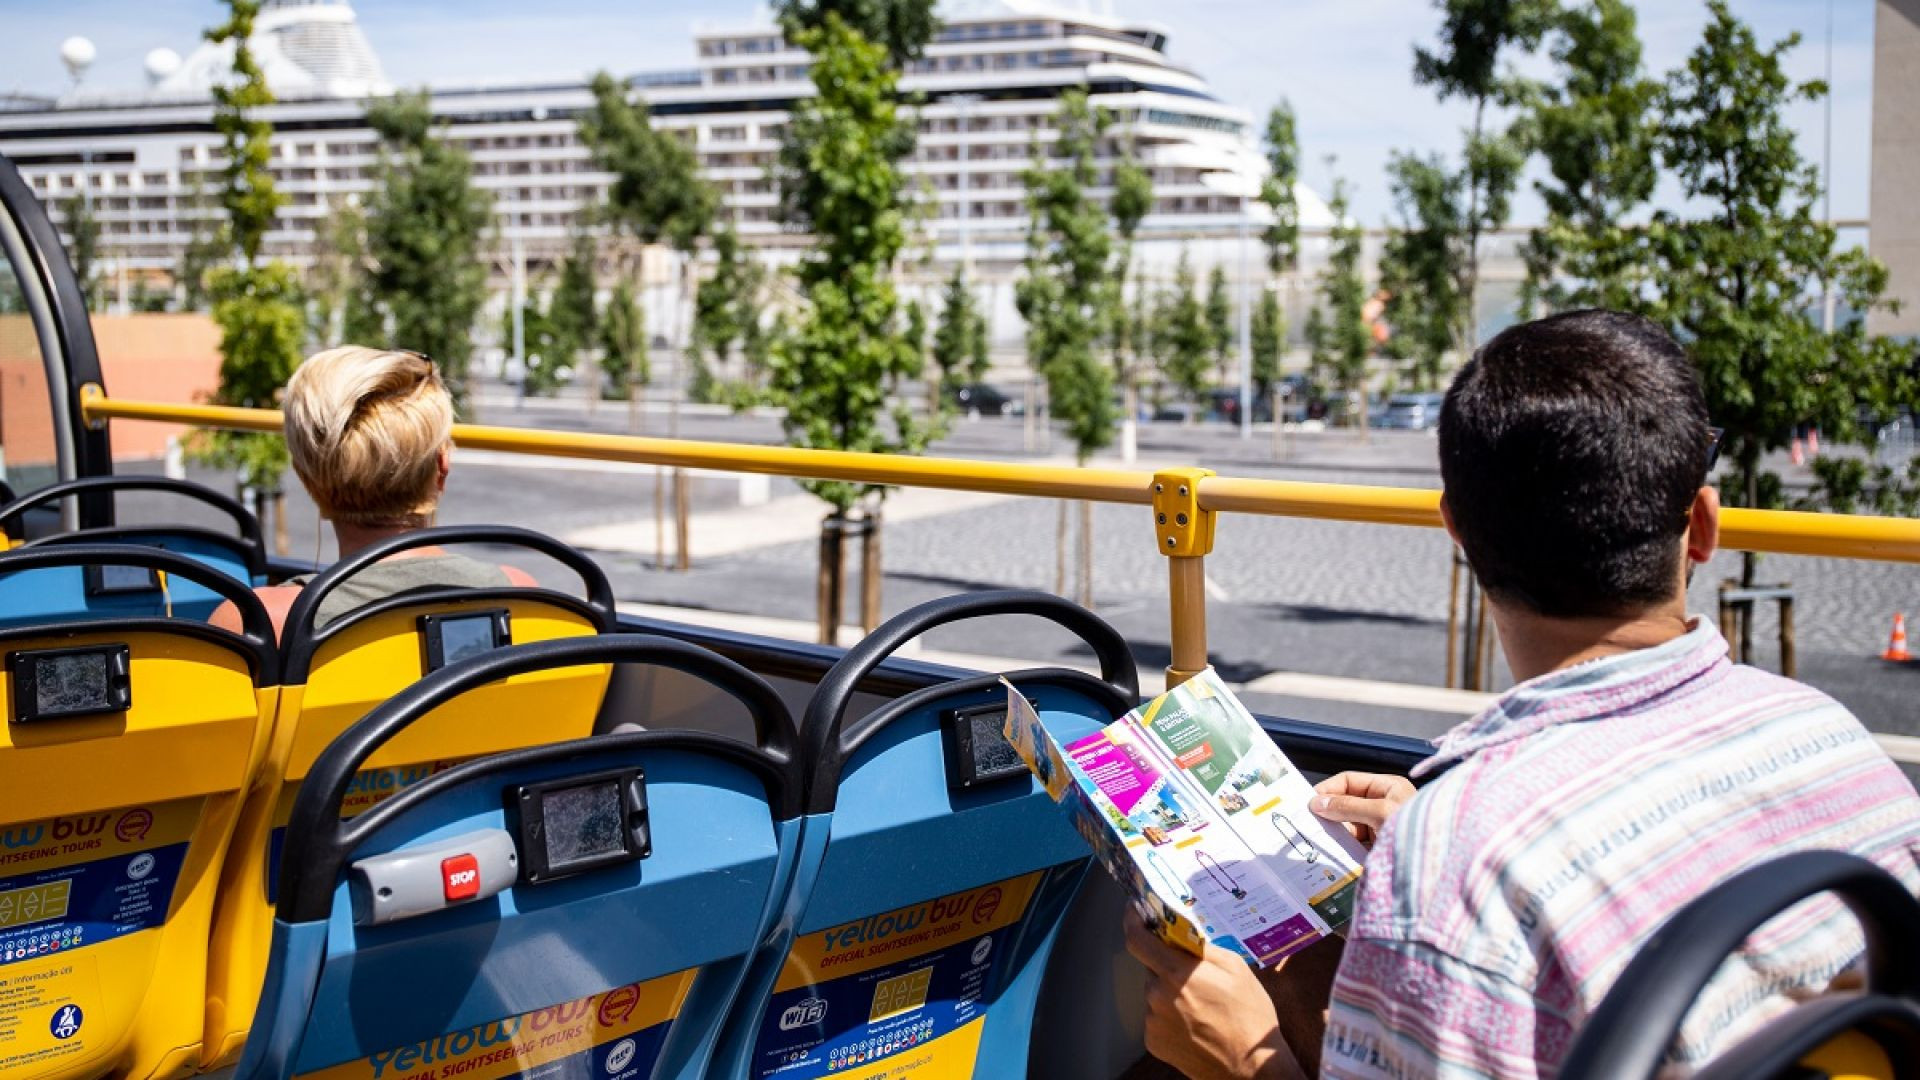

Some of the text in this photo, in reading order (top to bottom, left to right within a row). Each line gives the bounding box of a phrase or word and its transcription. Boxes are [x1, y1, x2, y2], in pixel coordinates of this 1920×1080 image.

[346, 766, 429, 793] ellow
[62, 838, 102, 854] TOURS
[450, 869, 476, 888] STOP
[820, 920, 962, 968] OFFICIAL SIGHTSEEING TOURS
[441, 1040, 535, 1079] SIGHTSEEING
[540, 1025, 583, 1048] TOURS
